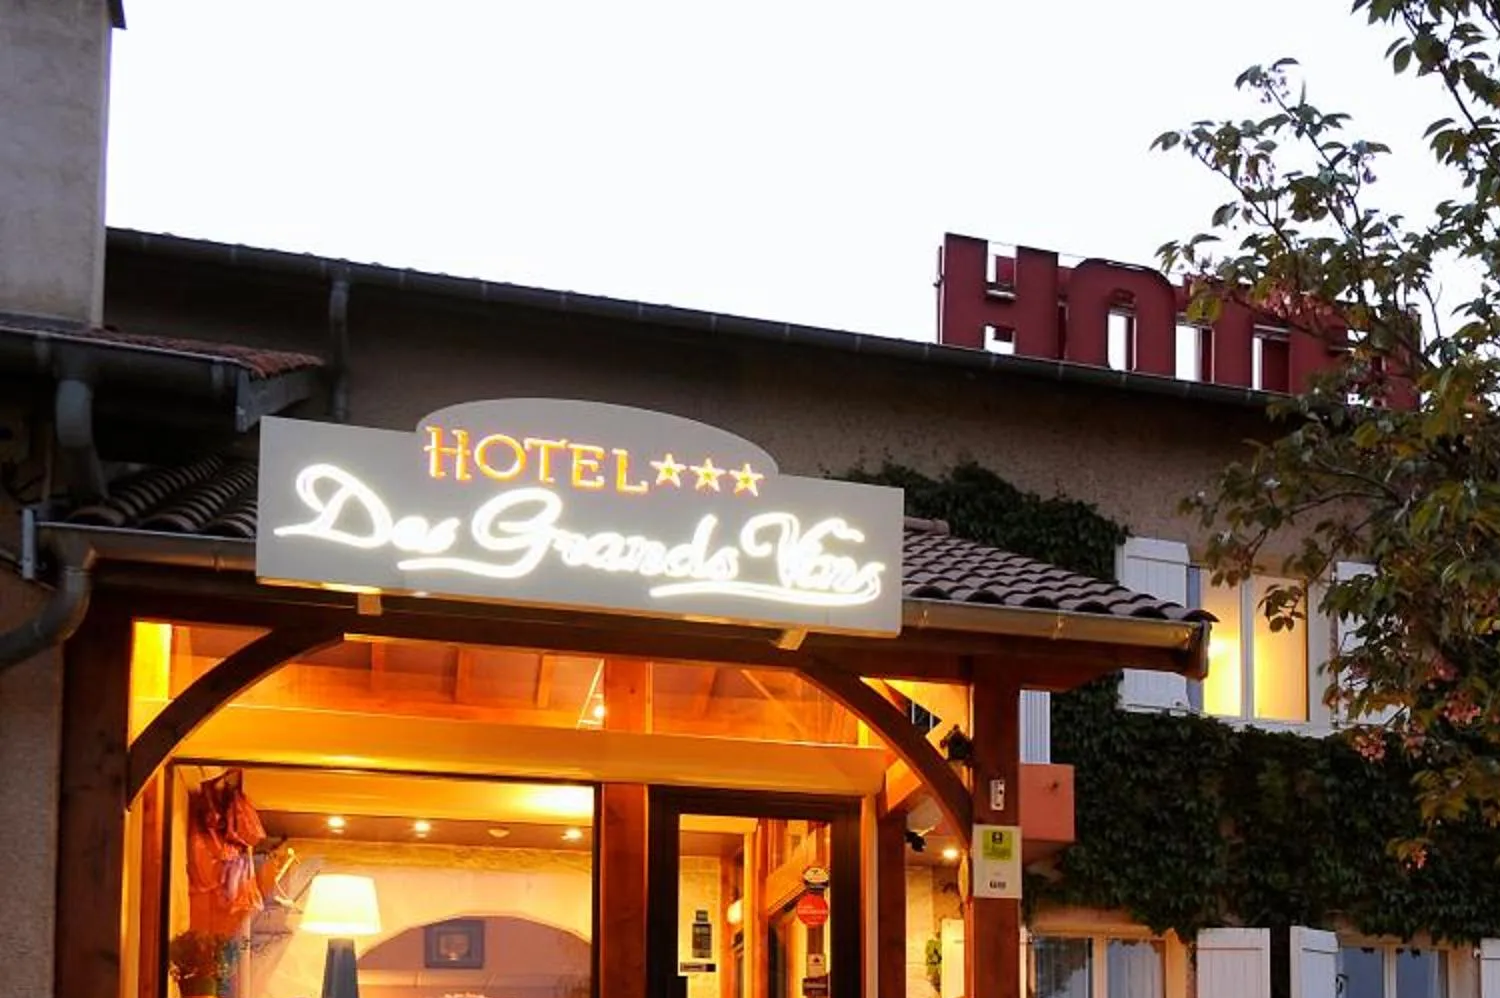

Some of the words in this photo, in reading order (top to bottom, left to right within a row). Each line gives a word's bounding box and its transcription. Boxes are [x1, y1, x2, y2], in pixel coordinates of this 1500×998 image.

[423, 424, 649, 495] HOTEL
[273, 463, 461, 554] Des
[395, 487, 743, 577] Grands
